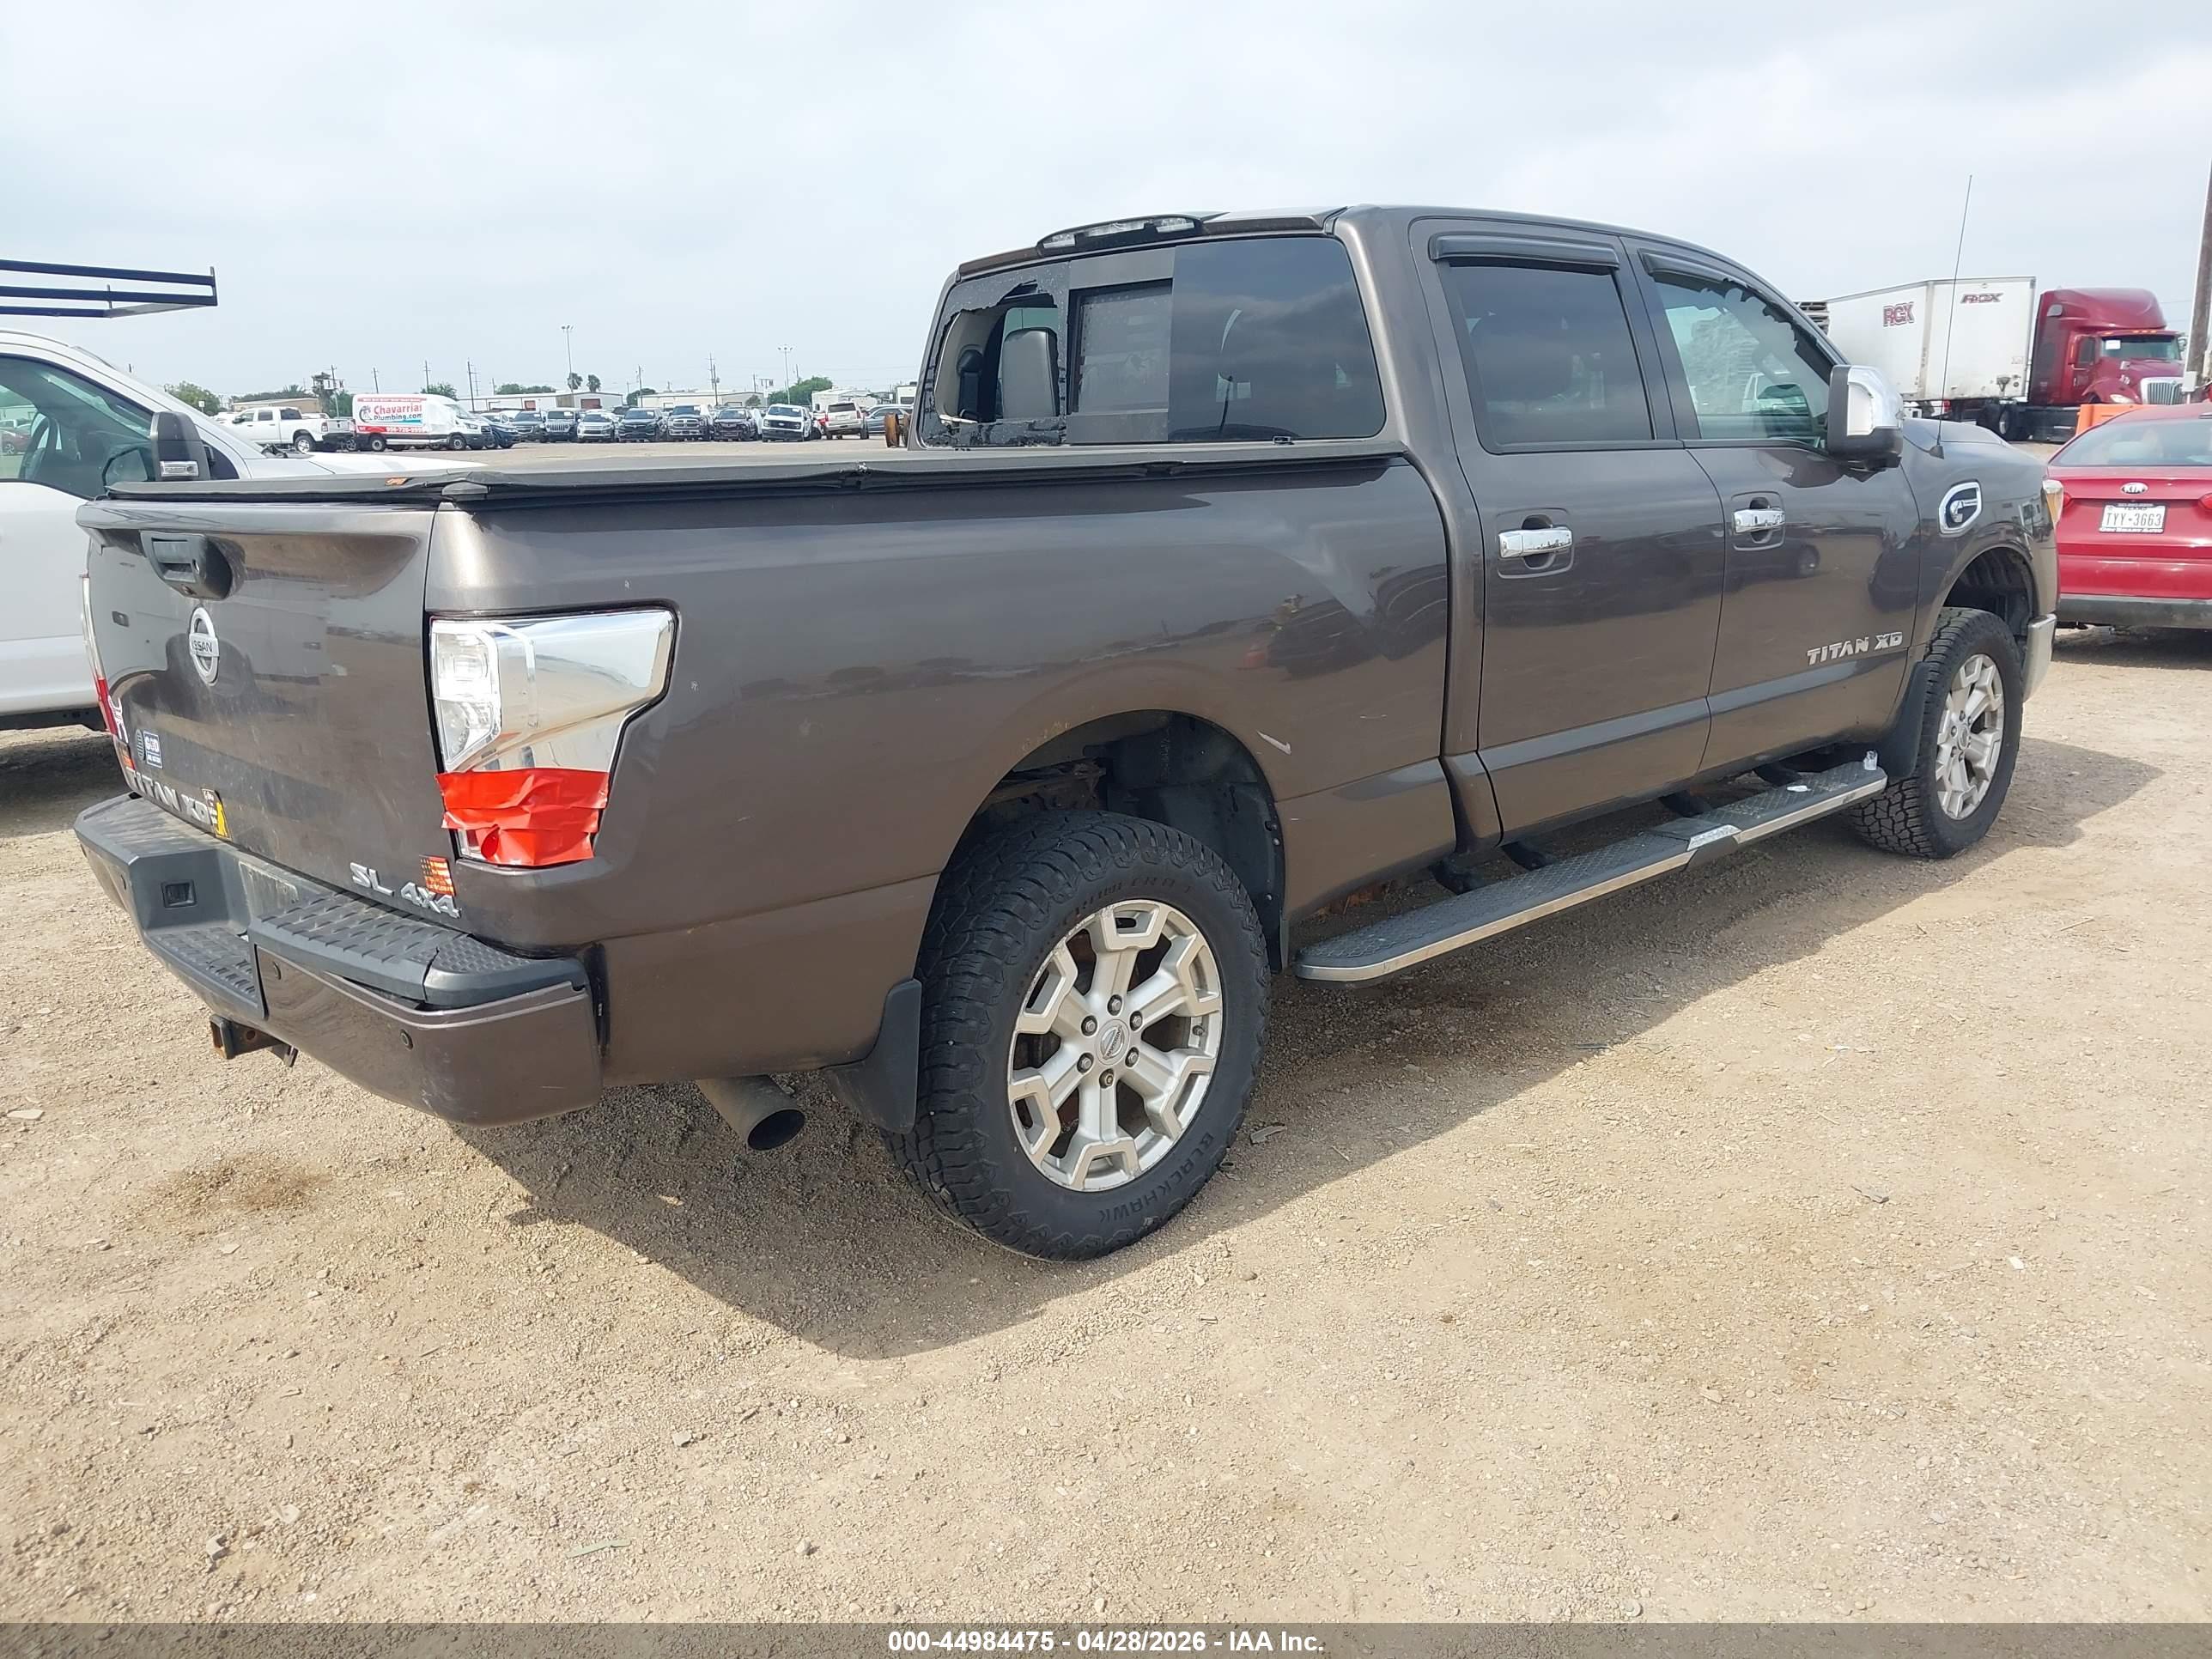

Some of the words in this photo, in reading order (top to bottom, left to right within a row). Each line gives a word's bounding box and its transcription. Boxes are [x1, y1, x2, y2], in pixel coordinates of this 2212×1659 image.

[1882, 301, 1915, 326] RGX
[2124, 484, 2145, 494] KIA
[1807, 637, 1869, 665] TITAN
[1875, 631, 1903, 650] XD
[125, 766, 181, 811] TITAN
[181, 793, 213, 825] XD
[350, 862, 394, 896] SL
[1099, 1132, 1214, 1224] BLACKHAWK
